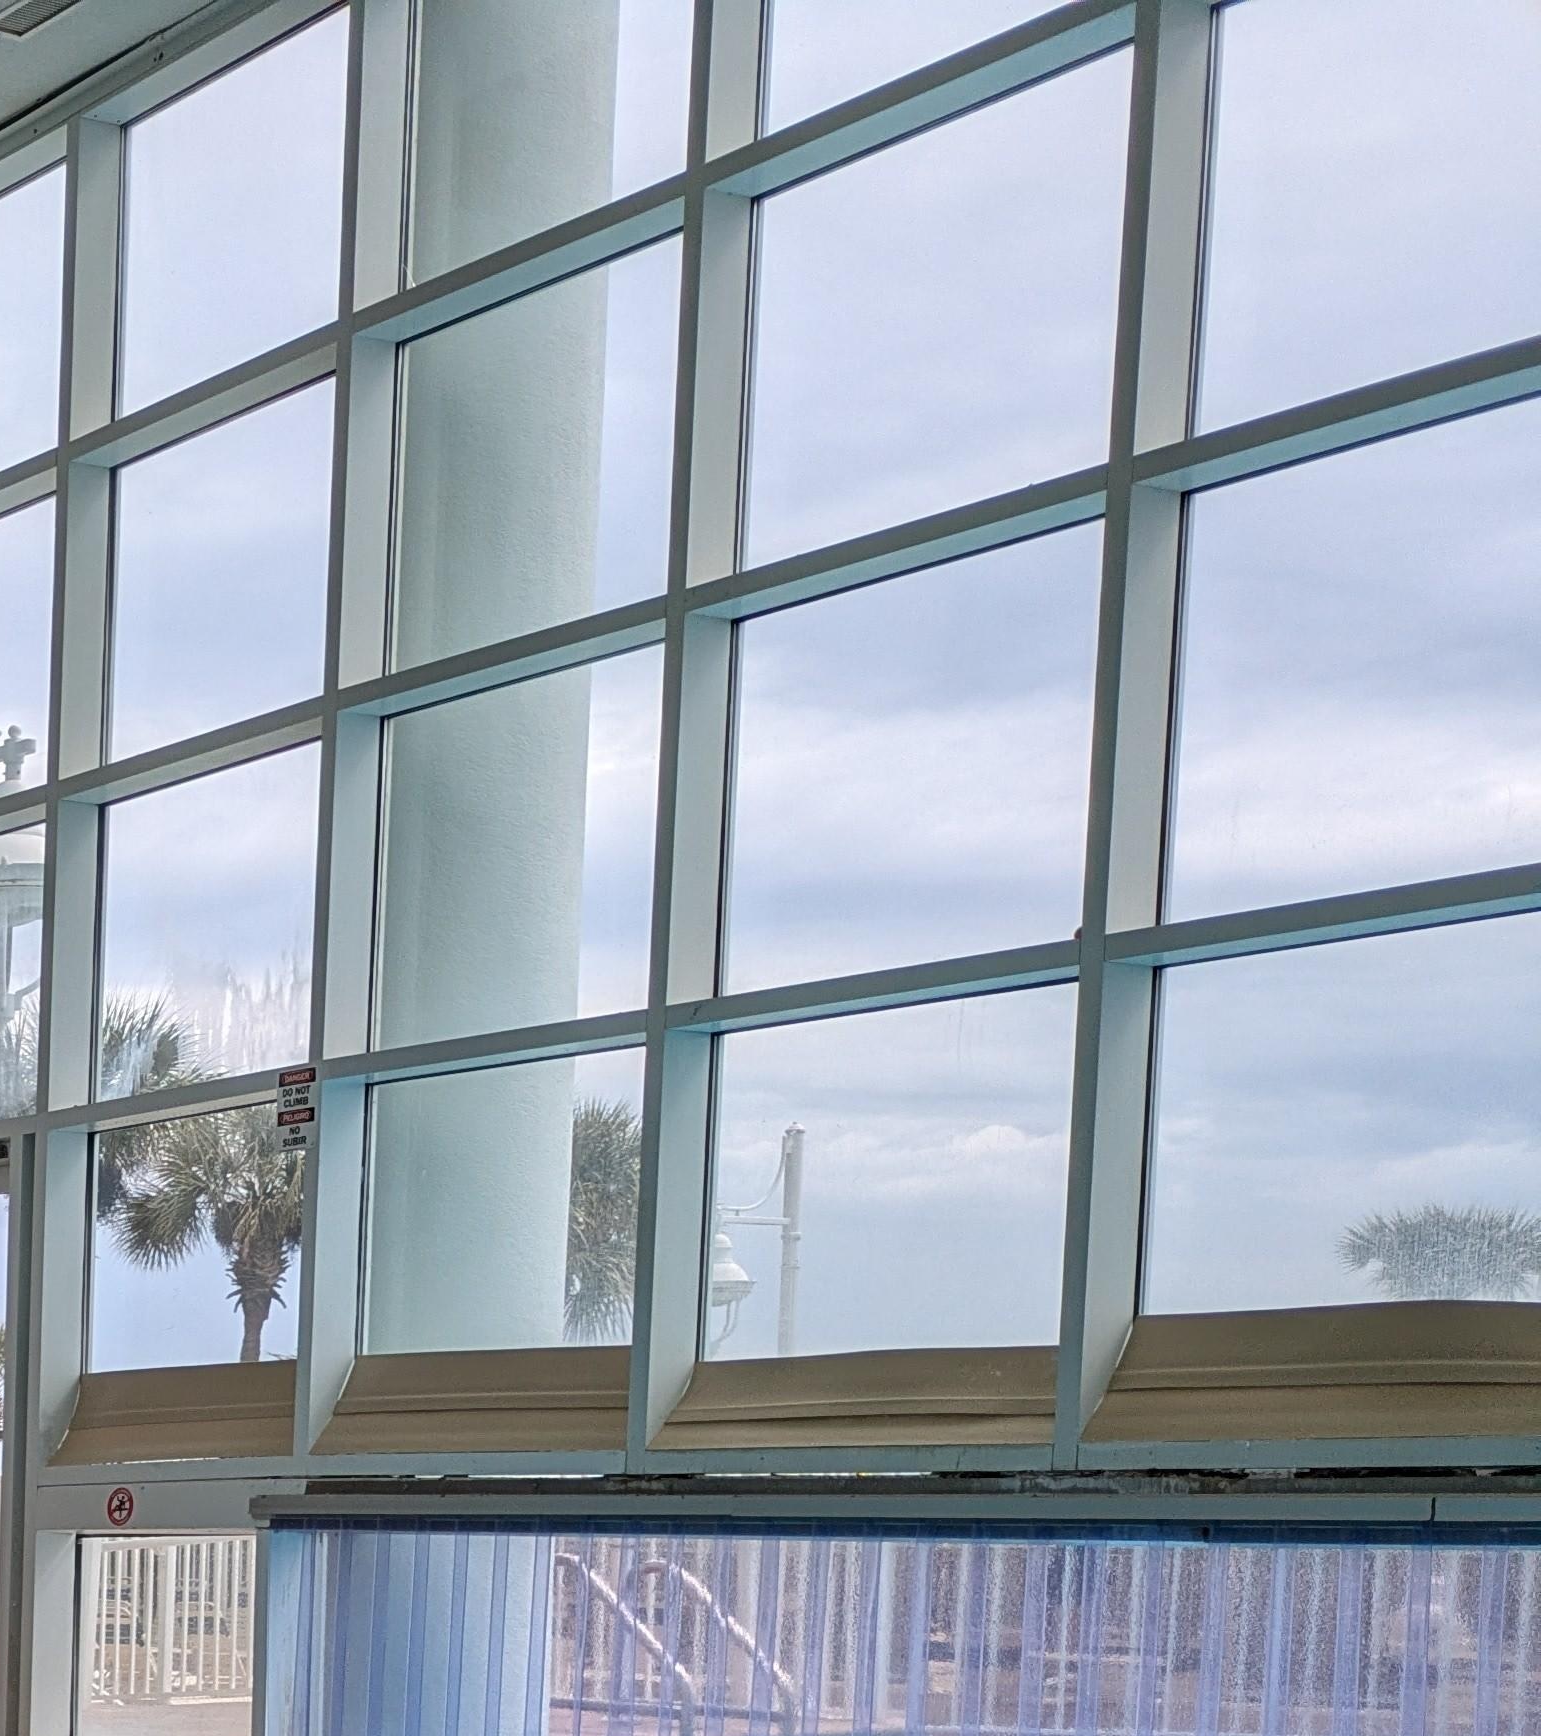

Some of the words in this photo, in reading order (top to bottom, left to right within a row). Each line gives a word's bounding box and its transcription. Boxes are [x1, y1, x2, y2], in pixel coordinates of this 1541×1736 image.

[282, 1088, 293, 1098] DO
[295, 1085, 311, 1096] NOT
[284, 1096, 309, 1108] CLIMB
[289, 1126, 300, 1136] NO
[283, 1135, 307, 1147] SUBIR
